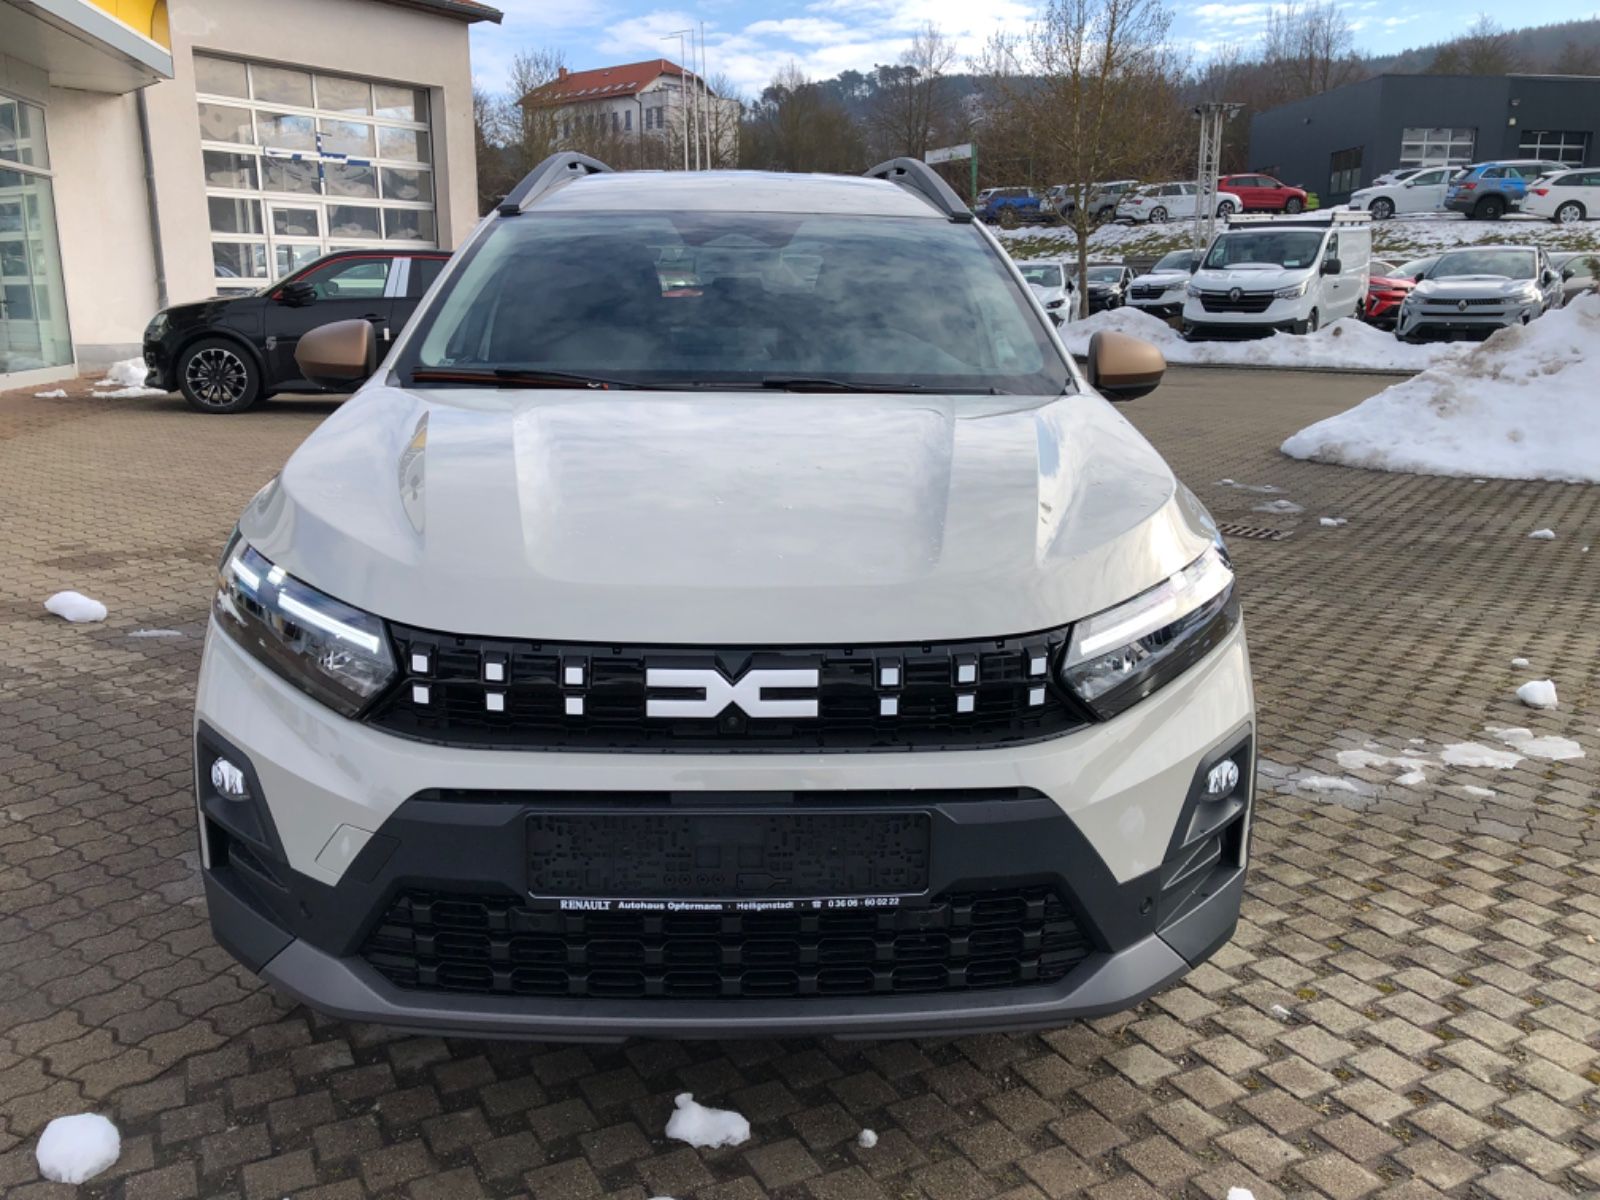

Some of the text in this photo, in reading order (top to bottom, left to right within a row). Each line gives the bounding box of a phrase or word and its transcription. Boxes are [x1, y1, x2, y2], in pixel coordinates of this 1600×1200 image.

[560, 899, 611, 910] RENAULT
[618, 901, 665, 910] Autohaus
[668, 901, 722, 912] Opfermann
[736, 901, 794, 912] Heiligenstadt
